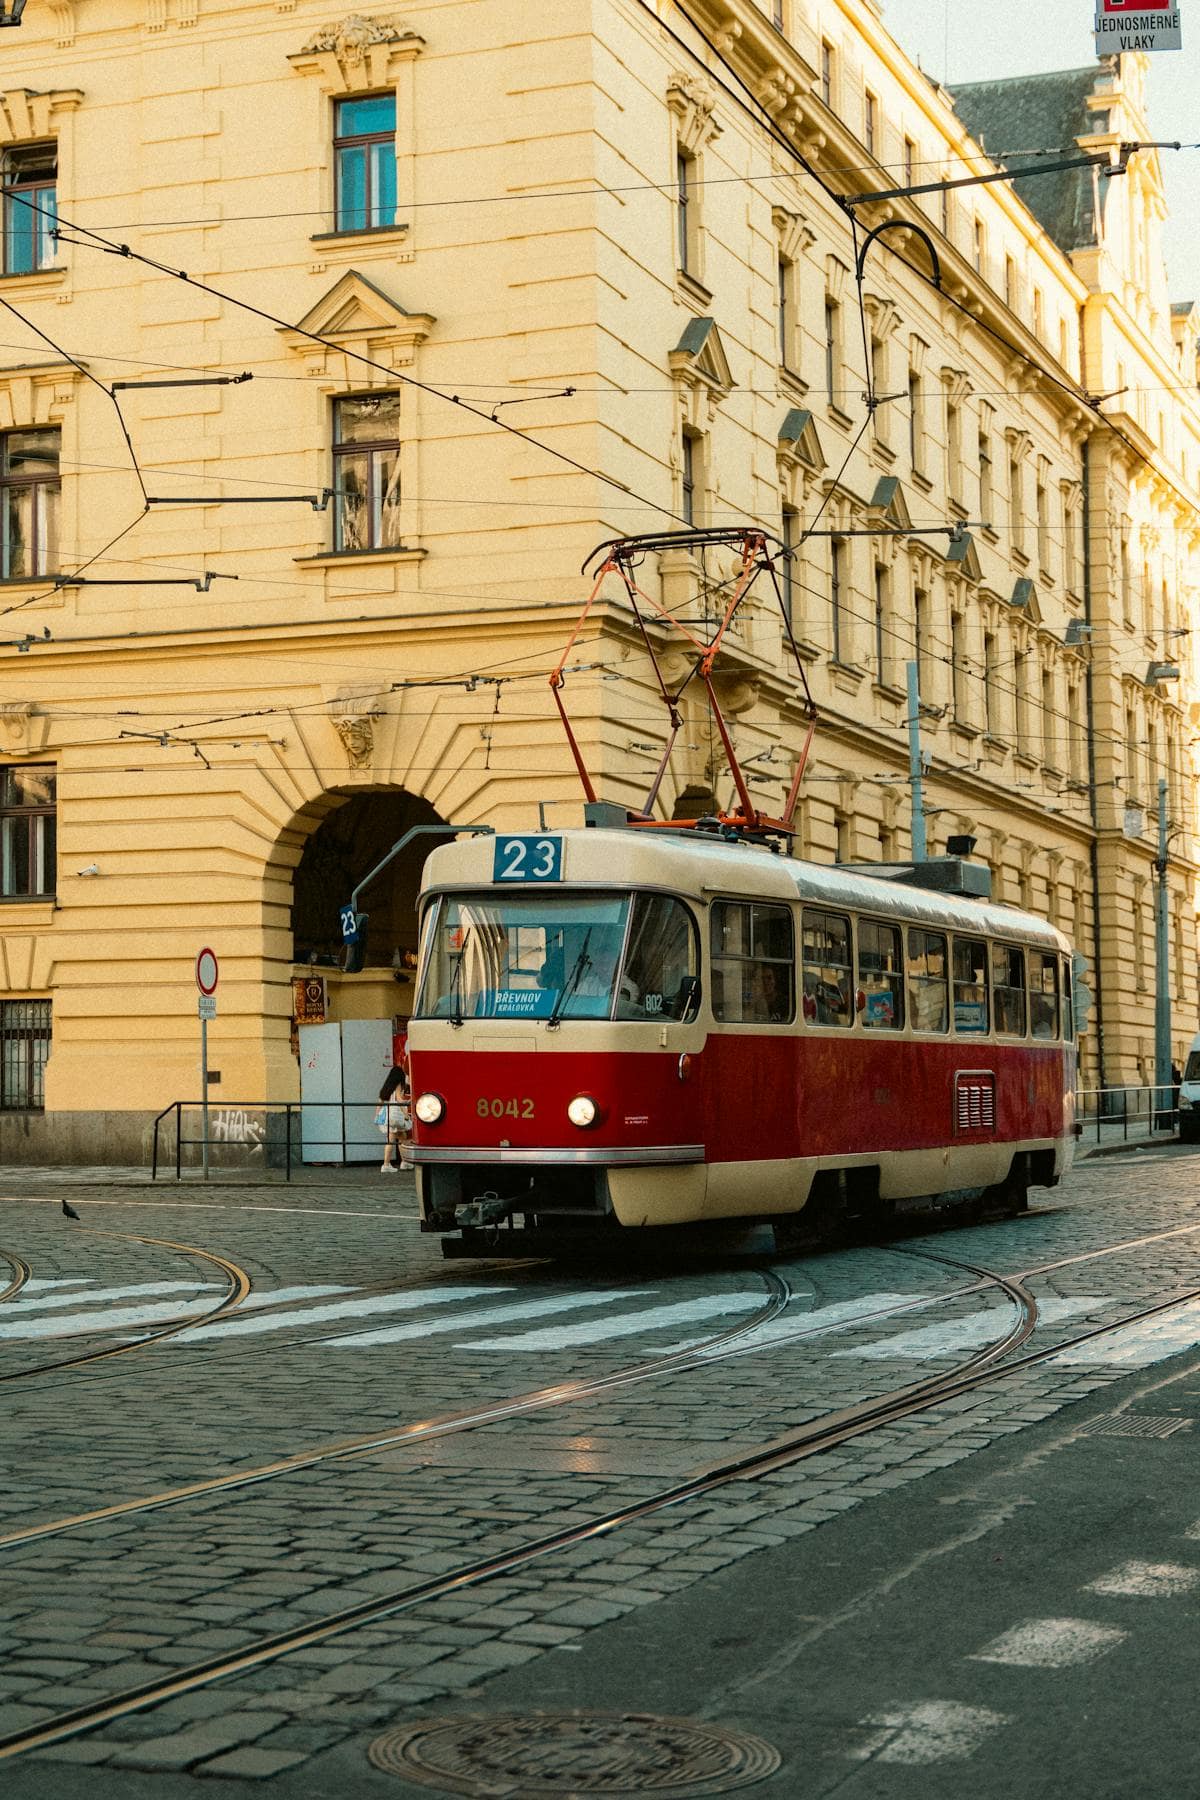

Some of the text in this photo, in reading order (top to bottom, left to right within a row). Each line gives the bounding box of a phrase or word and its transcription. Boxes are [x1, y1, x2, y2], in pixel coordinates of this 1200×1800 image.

[1120, 35, 1155, 49] VLAKY
[501, 840, 555, 877] 23
[341, 911, 356, 936] 23
[496, 991, 541, 1003] BŘEVNOV
[646, 994, 663, 1011] 802
[477, 1098, 534, 1118] 8042
